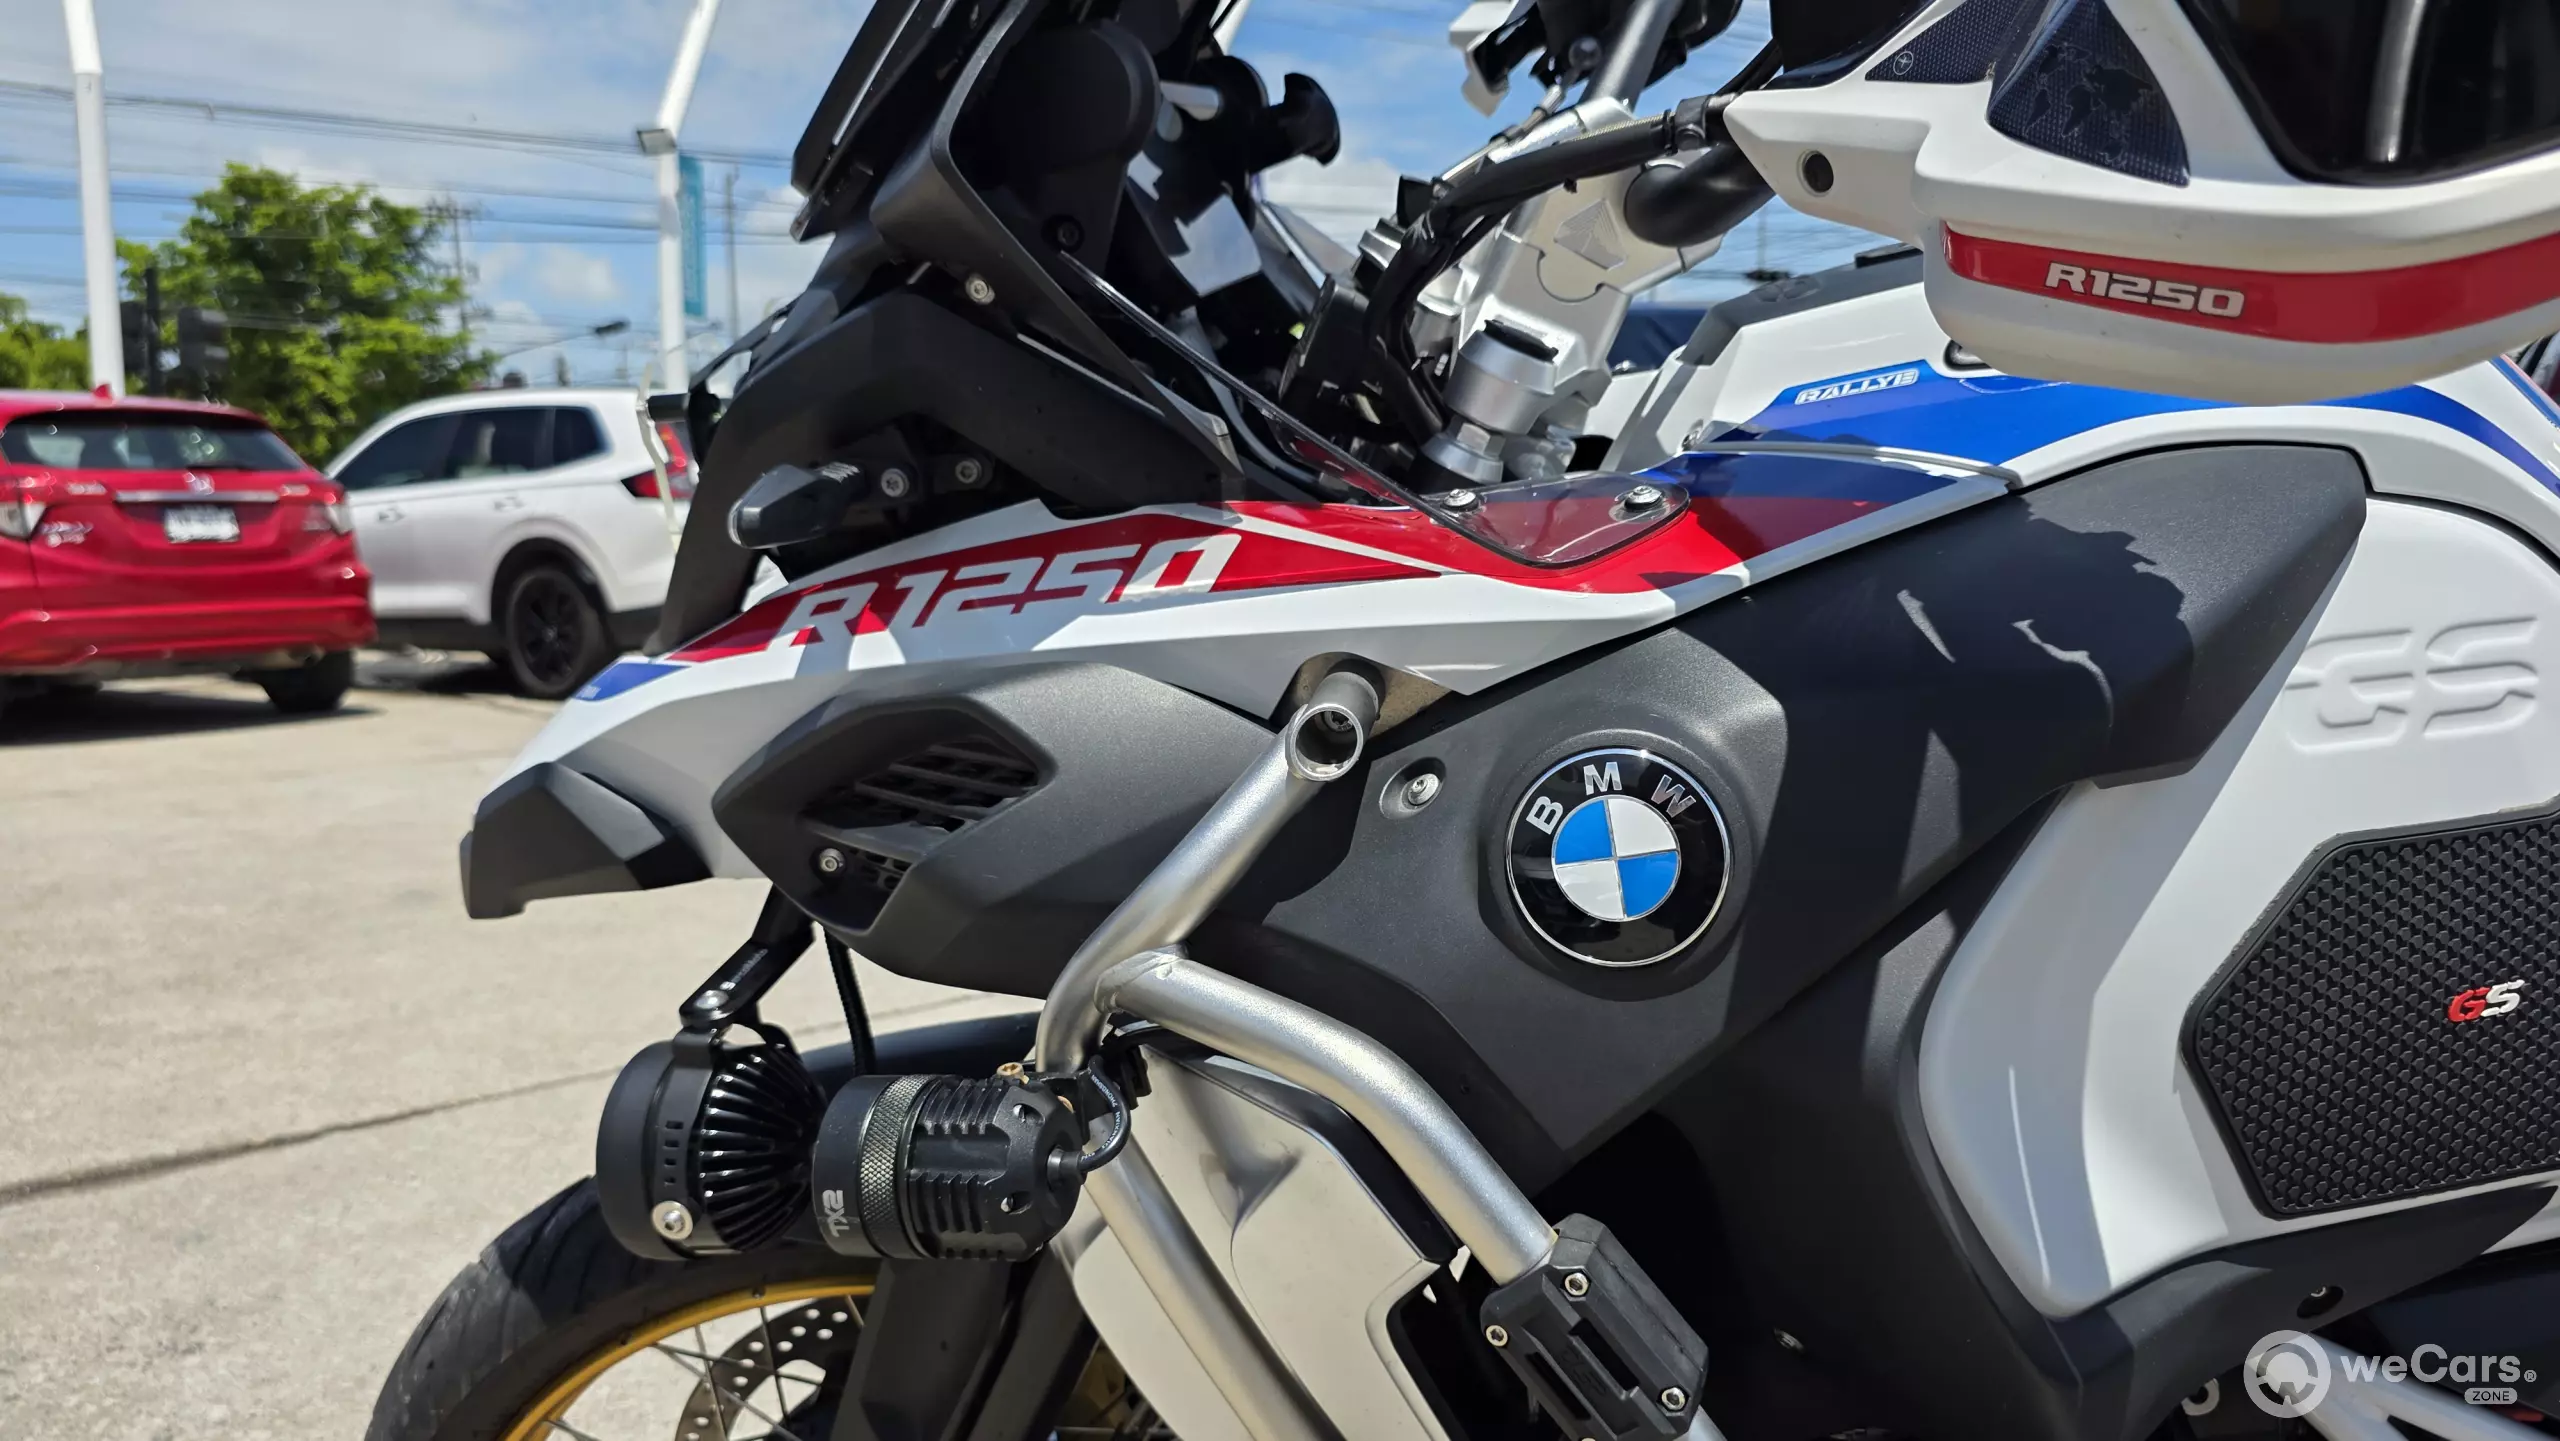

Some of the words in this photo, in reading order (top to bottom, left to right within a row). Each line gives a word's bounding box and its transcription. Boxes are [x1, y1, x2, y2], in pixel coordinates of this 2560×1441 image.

[2045, 261, 2245, 318] R1250
[1797, 370, 1917, 404] RALLYE
[780, 533, 1242, 652] R1250
[2281, 616, 2539, 754] GS
[1526, 761, 1697, 835] BMW
[2448, 979, 2525, 1022] GS
[822, 1189, 850, 1238] TX2
